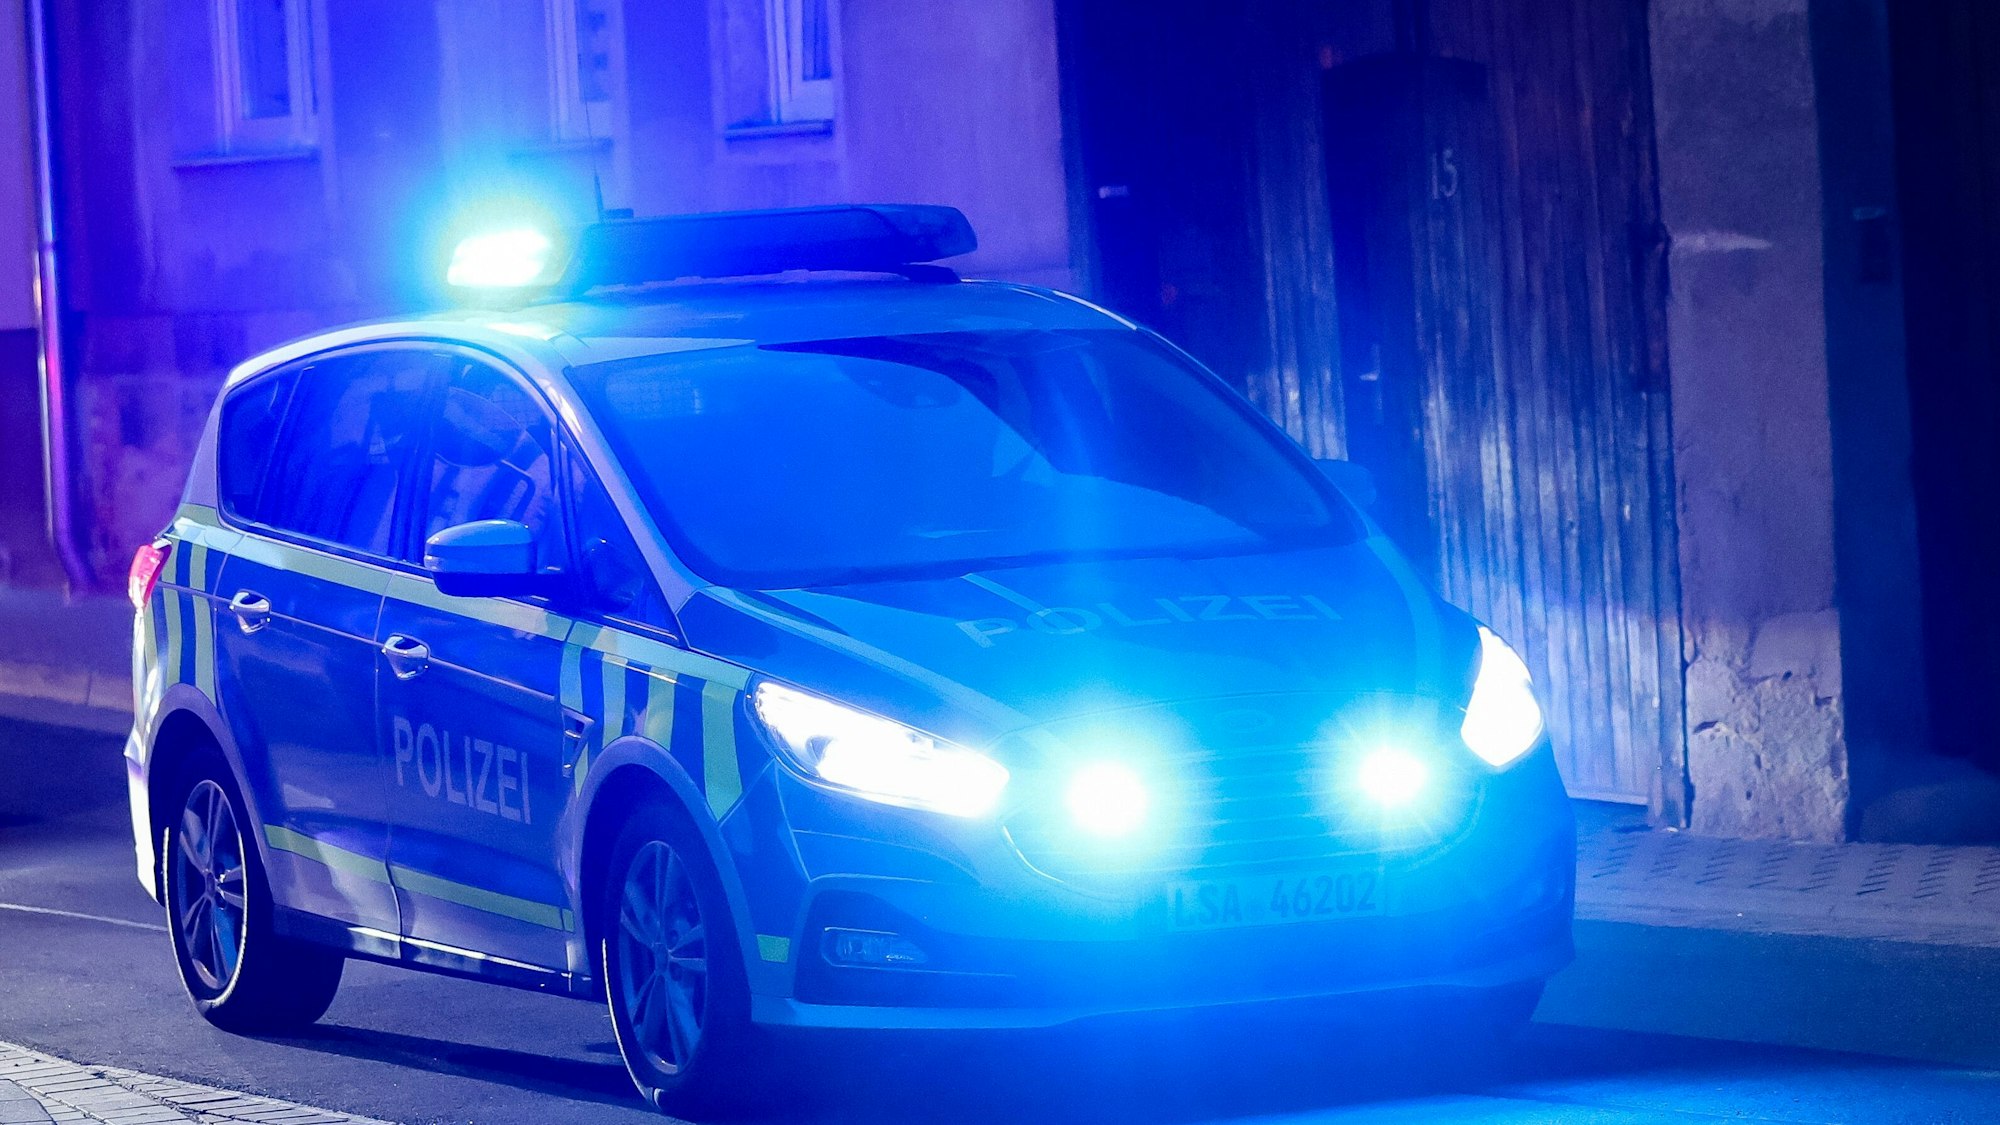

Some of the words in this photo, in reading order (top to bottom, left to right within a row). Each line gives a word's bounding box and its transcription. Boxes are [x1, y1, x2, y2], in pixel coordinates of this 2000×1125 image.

[1430, 147, 1458, 200] 15
[956, 594, 1343, 649] POLIZEI
[393, 715, 531, 825] POLIZEI
[1174, 884, 1243, 927] LSA
[1270, 871, 1377, 918] 46202
